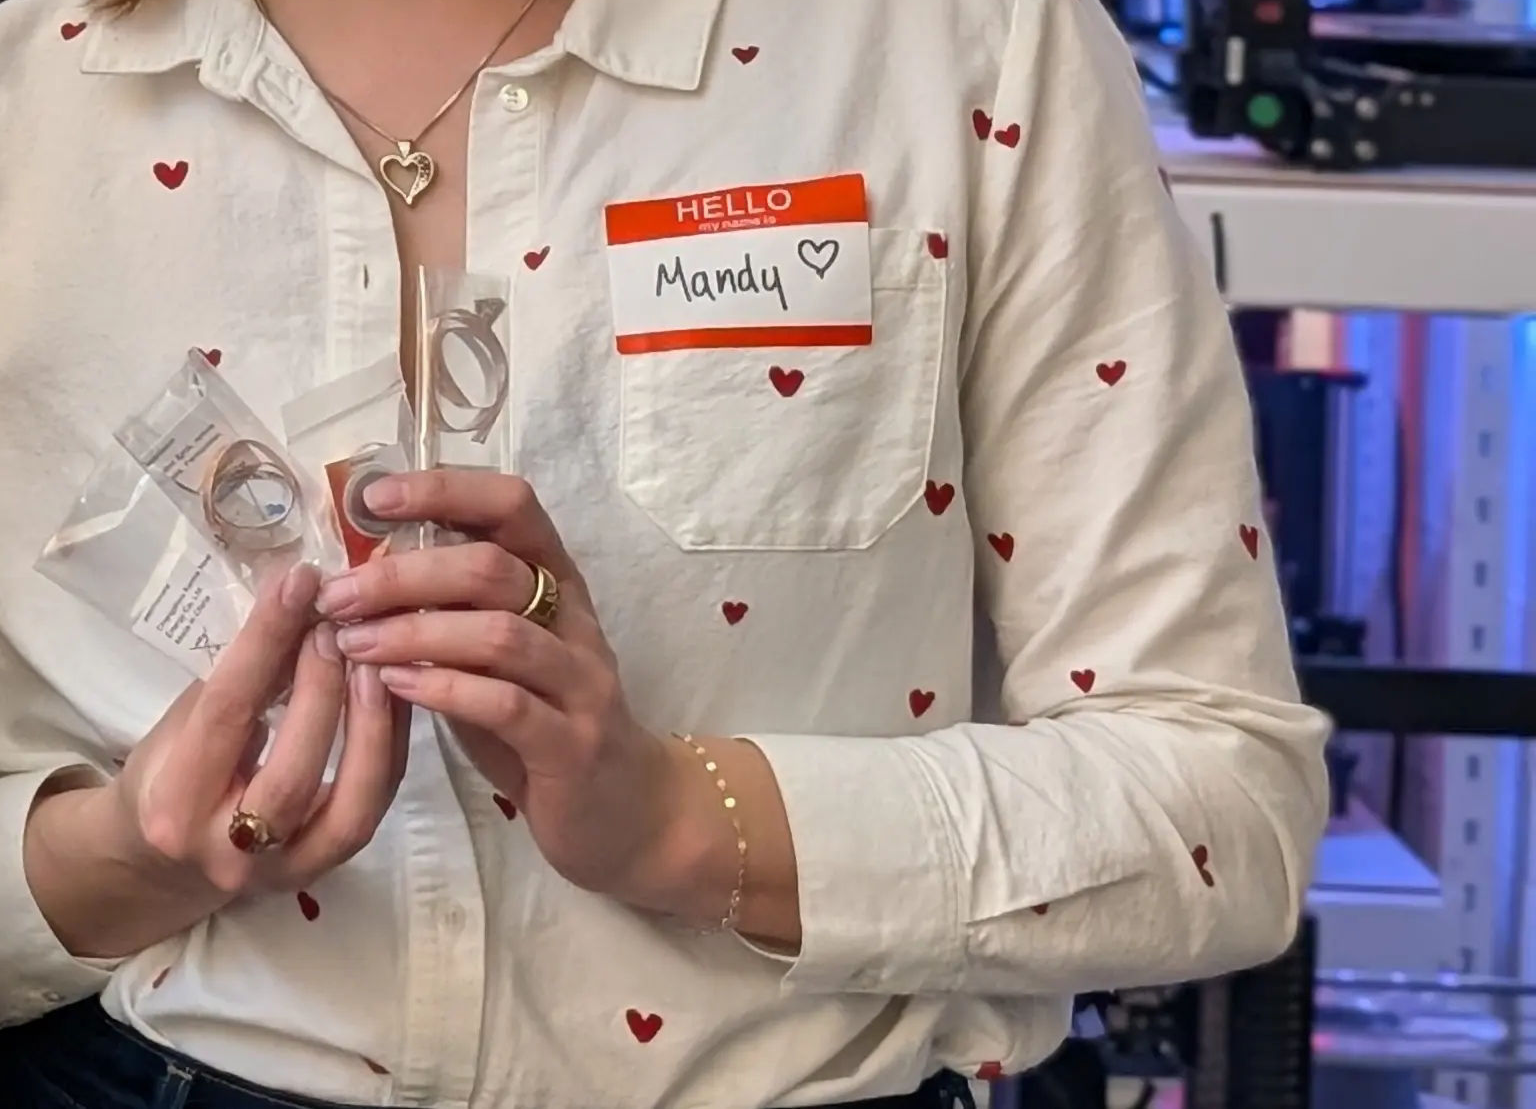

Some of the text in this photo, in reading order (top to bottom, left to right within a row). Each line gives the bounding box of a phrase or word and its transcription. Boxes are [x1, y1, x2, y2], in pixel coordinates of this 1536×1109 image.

[677, 189, 792, 222] HELLO
[698, 215, 777, 232] my name is
[656, 253, 788, 310] Mandy
